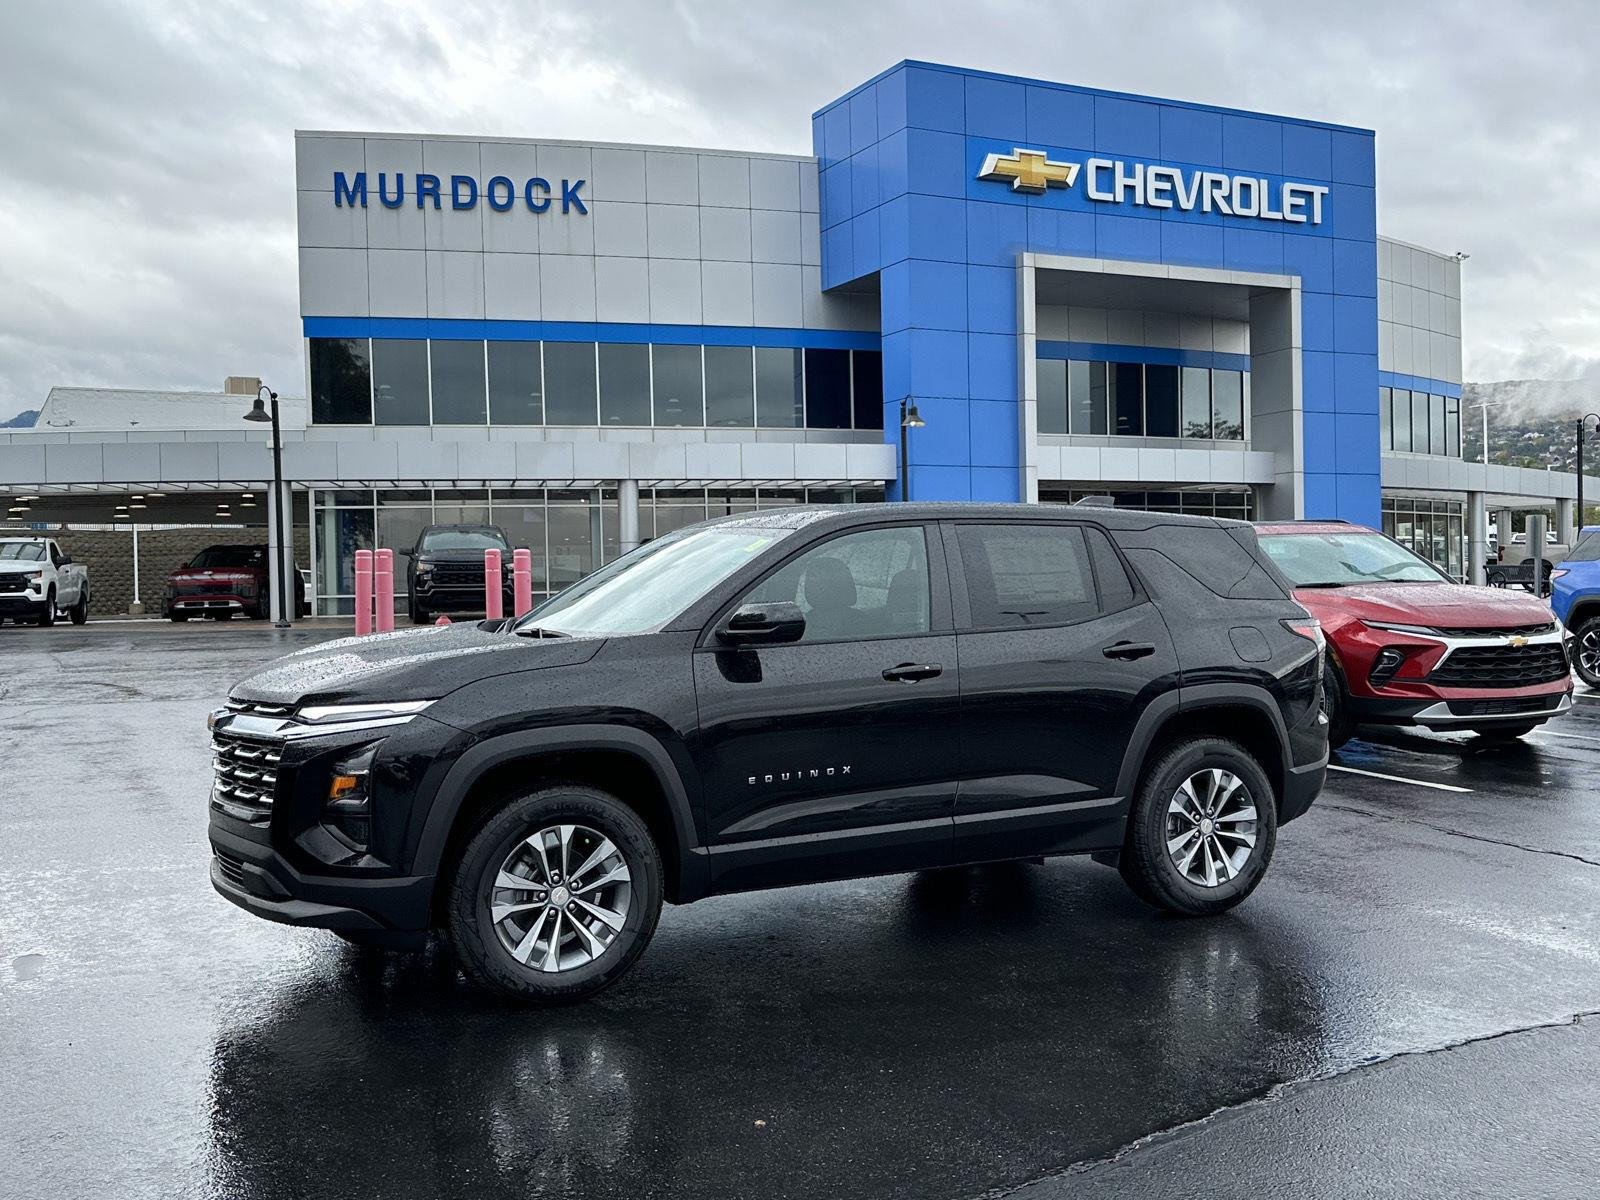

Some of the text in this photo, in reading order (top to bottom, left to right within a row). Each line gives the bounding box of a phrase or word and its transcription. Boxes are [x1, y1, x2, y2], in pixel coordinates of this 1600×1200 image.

[333, 171, 589, 215] MURDOCK
[1085, 158, 1330, 225] CHEVROLET
[748, 765, 851, 785] EQUINOX
